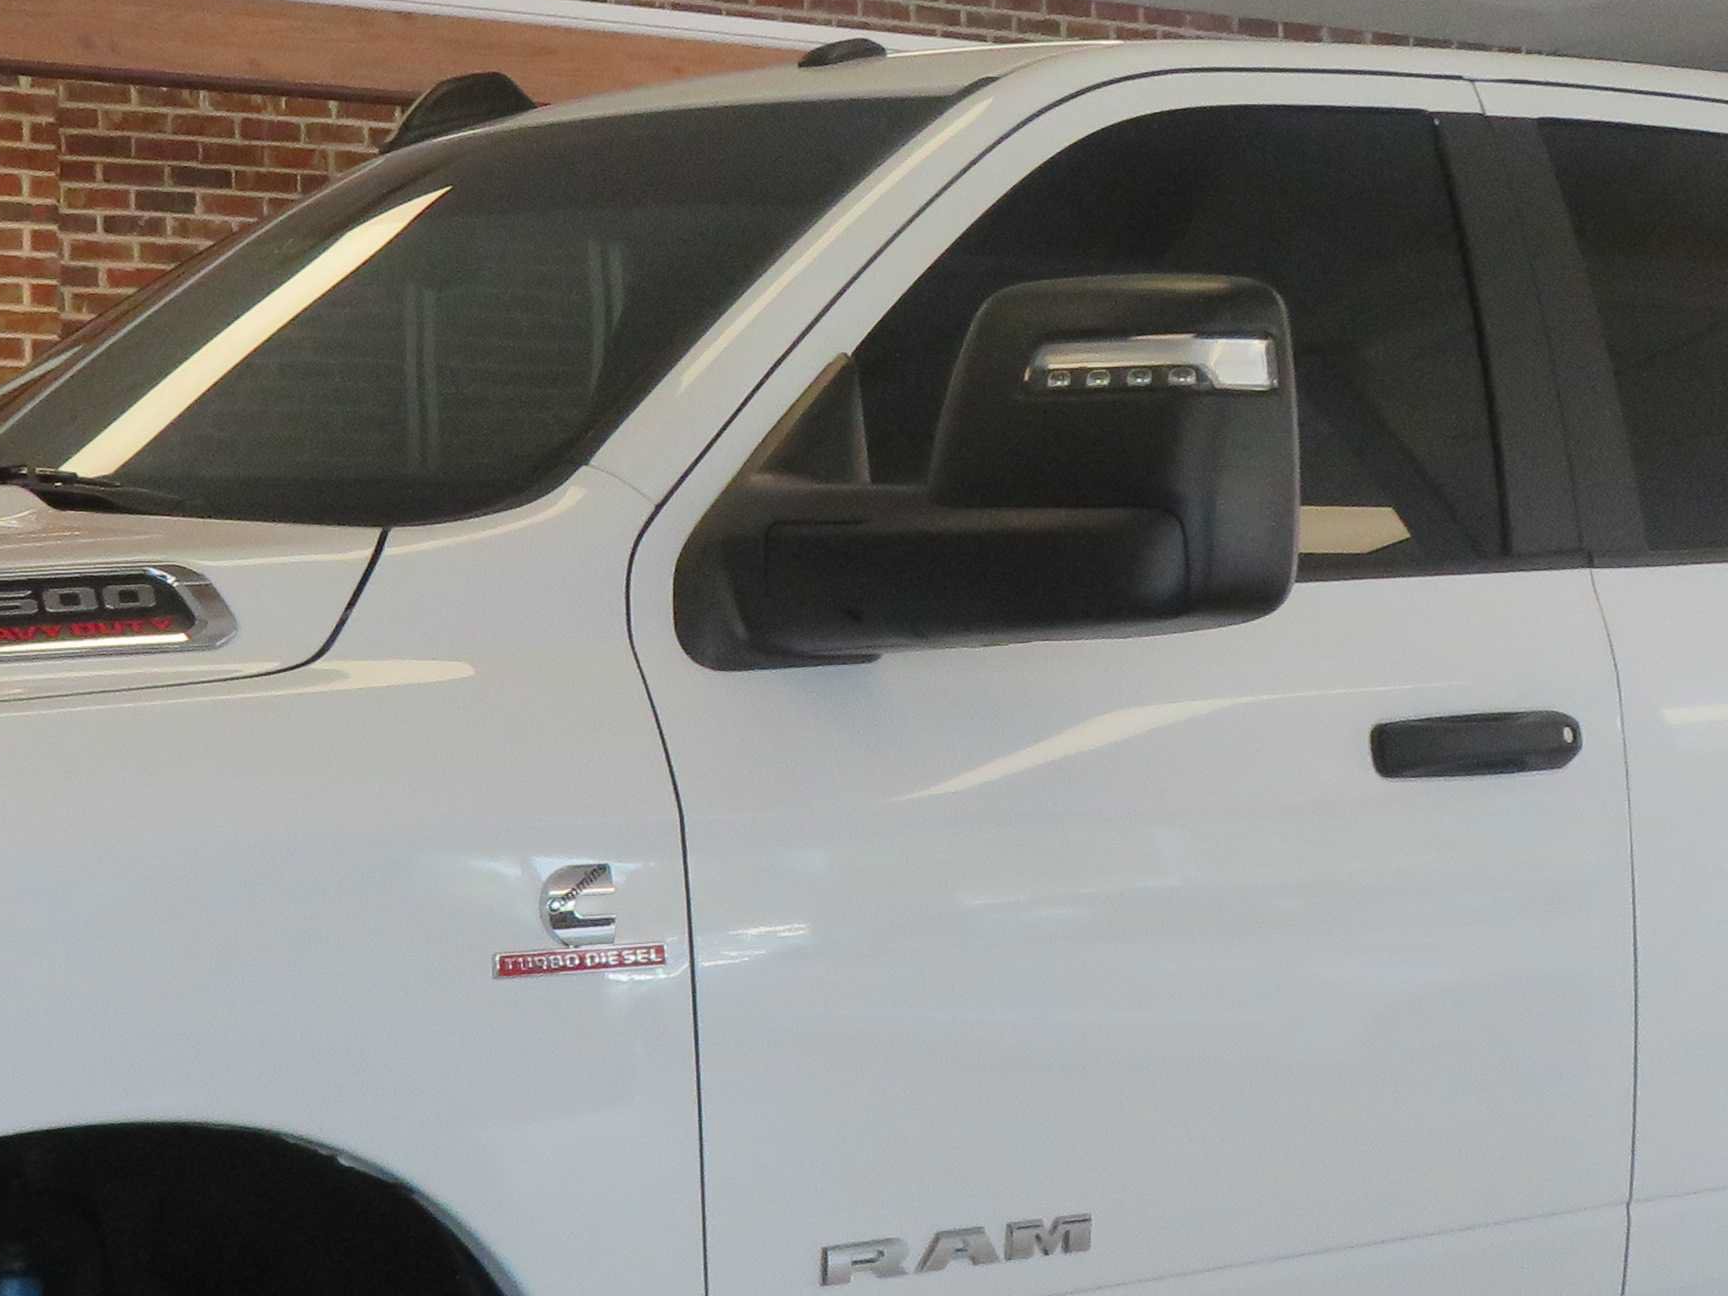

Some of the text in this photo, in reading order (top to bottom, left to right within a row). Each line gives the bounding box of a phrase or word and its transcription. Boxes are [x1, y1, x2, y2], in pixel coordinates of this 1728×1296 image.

[69, 616, 172, 638] DUTY
[502, 948, 664, 972] TURBO DIESEL
[819, 1212, 1093, 1287] RAM
